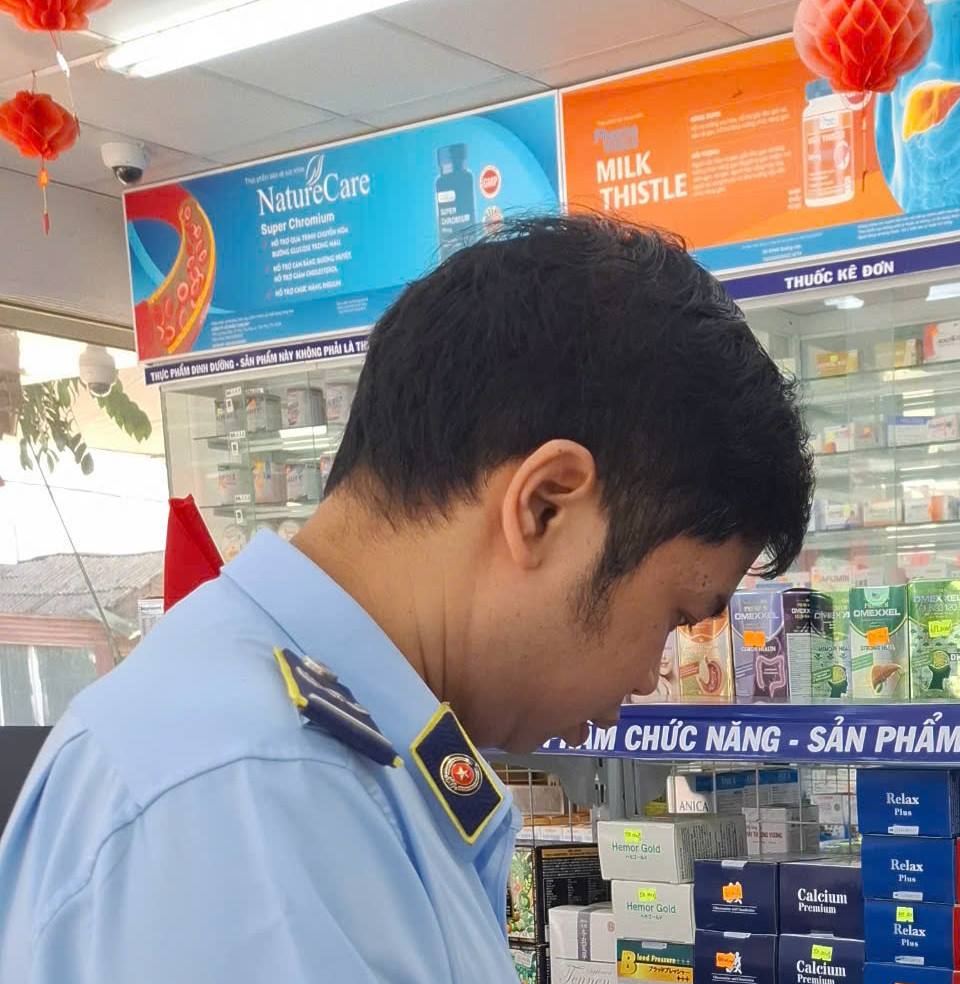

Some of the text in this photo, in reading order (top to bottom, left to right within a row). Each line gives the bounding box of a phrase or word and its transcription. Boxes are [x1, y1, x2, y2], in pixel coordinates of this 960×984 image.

[596, 151, 652, 185] MILK
[257, 173, 371, 216] NatureCare
[600, 174, 687, 211] THISTLE
[261, 212, 334, 236] Super Chromium
[785, 260, 895, 289] THUỐC KÊ ĐƠN
[625, 719, 697, 751] CHỨC
[705, 722, 781, 752] NĂNG
[808, 715, 879, 753] SẢN
[886, 792, 919, 806] Relax
[895, 808, 912, 816] Plus
[612, 842, 660, 854] Hemor Gold
[891, 860, 923, 873] Relax
[898, 874, 916, 883] Plus
[798, 888, 847, 905] Calcium
[627, 902, 676, 914] Hemor Gold
[798, 903, 836, 914] Premium
[894, 924, 926, 938] Relax
[901, 939, 918, 948] Plus
[797, 960, 846, 977] Calcium
